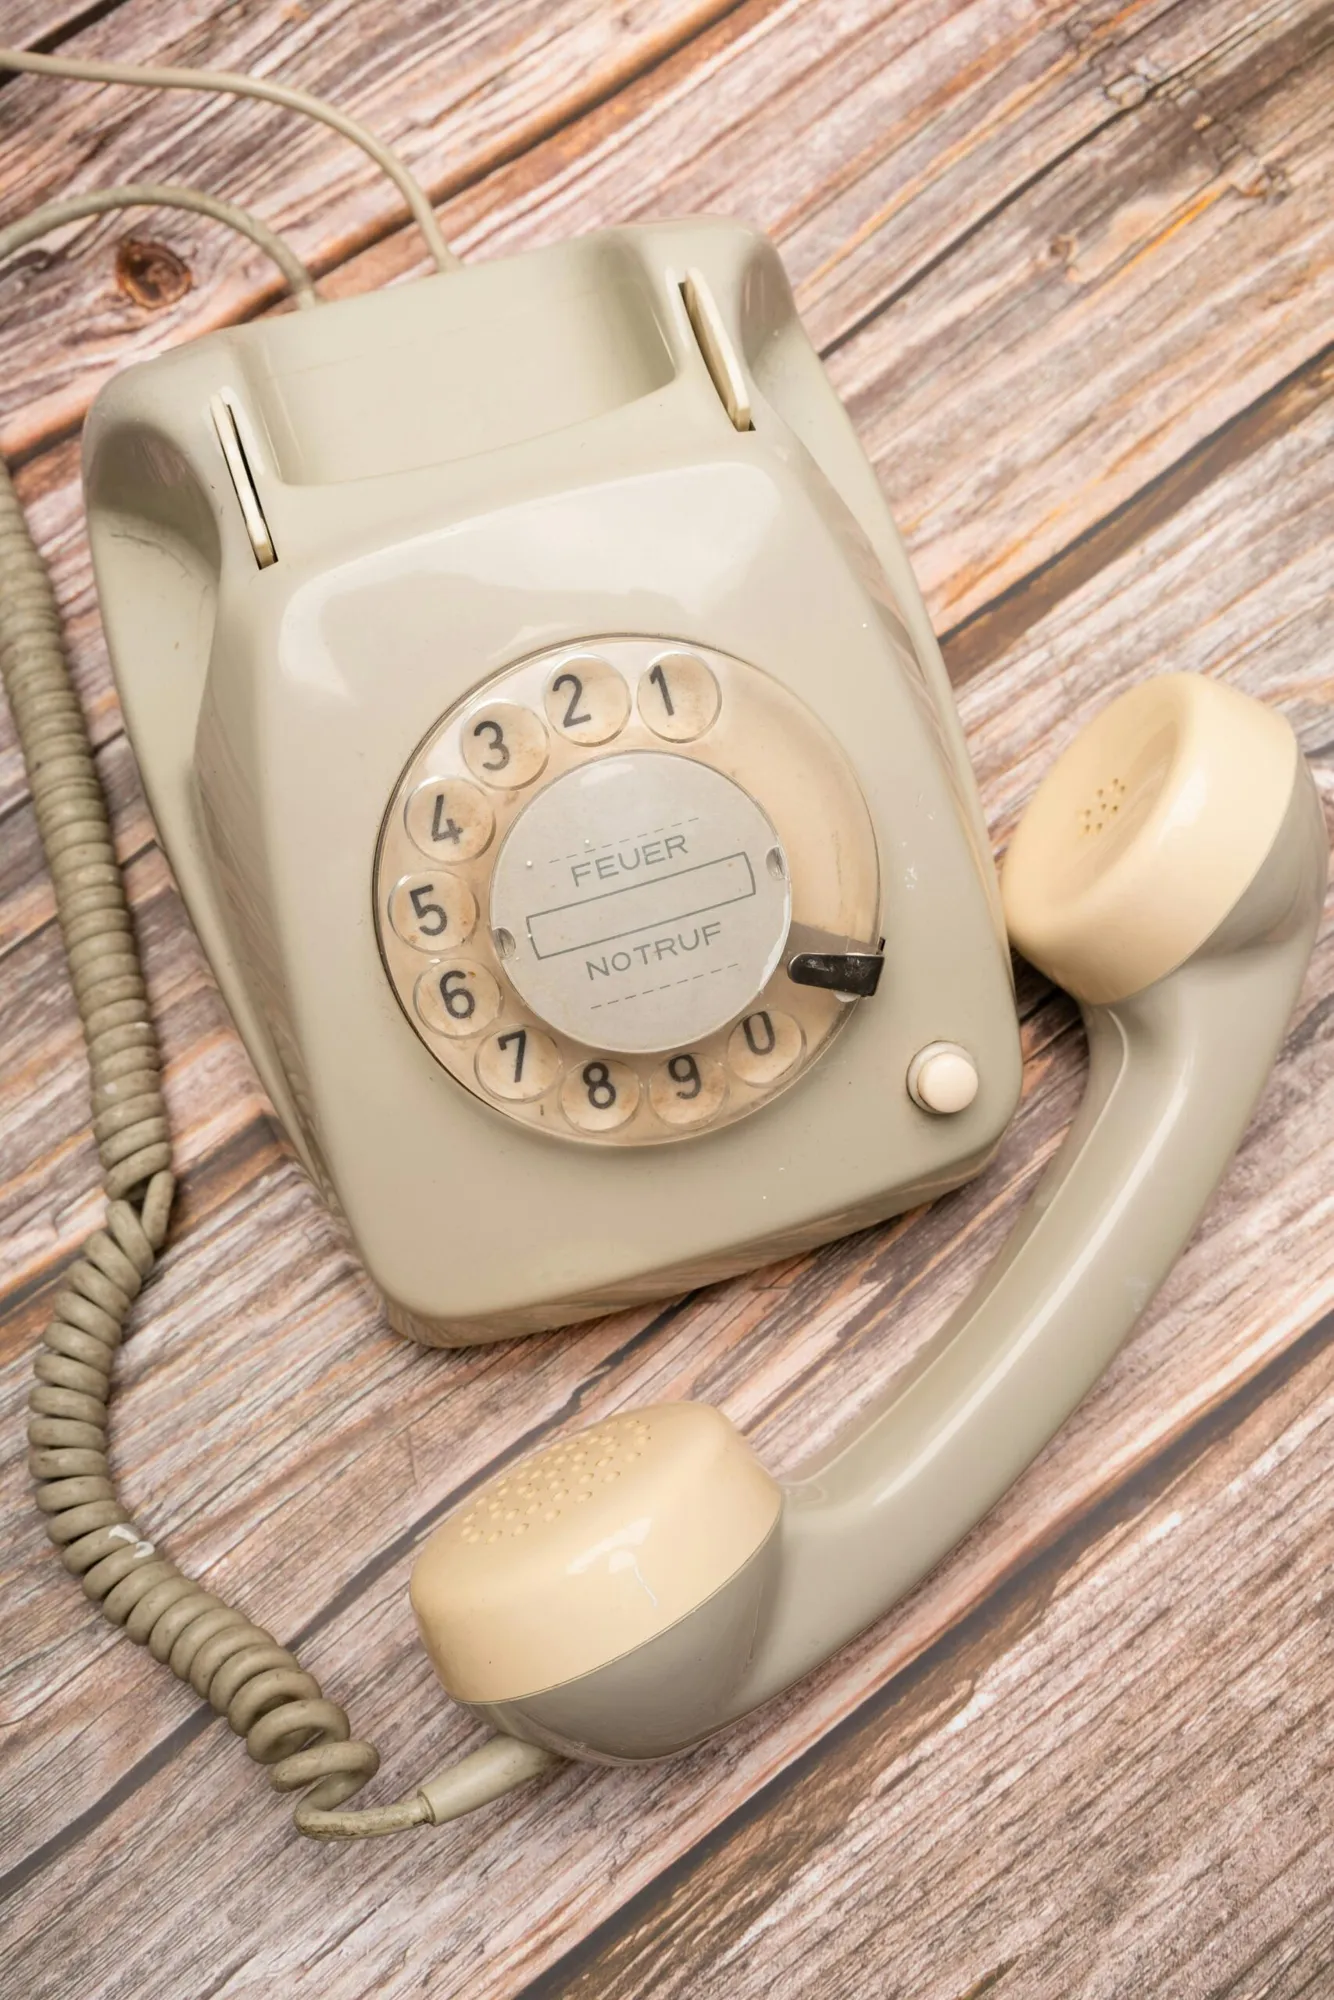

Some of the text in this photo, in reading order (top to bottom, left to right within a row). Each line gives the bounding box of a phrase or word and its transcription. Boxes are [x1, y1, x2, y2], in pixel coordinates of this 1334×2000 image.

[551, 673, 592, 728] 2
[649, 664, 676, 717] 1
[473, 720, 512, 772] 3
[430, 794, 464, 845] 4
[570, 834, 689, 888] FEUER
[408, 884, 448, 937] 5
[585, 921, 722, 981] NOTRUF
[438, 969, 476, 1020] 6
[497, 1030, 528, 1083] 7
[742, 1010, 777, 1056] 0
[581, 1061, 617, 1110] 8
[667, 1054, 702, 1100] 9
